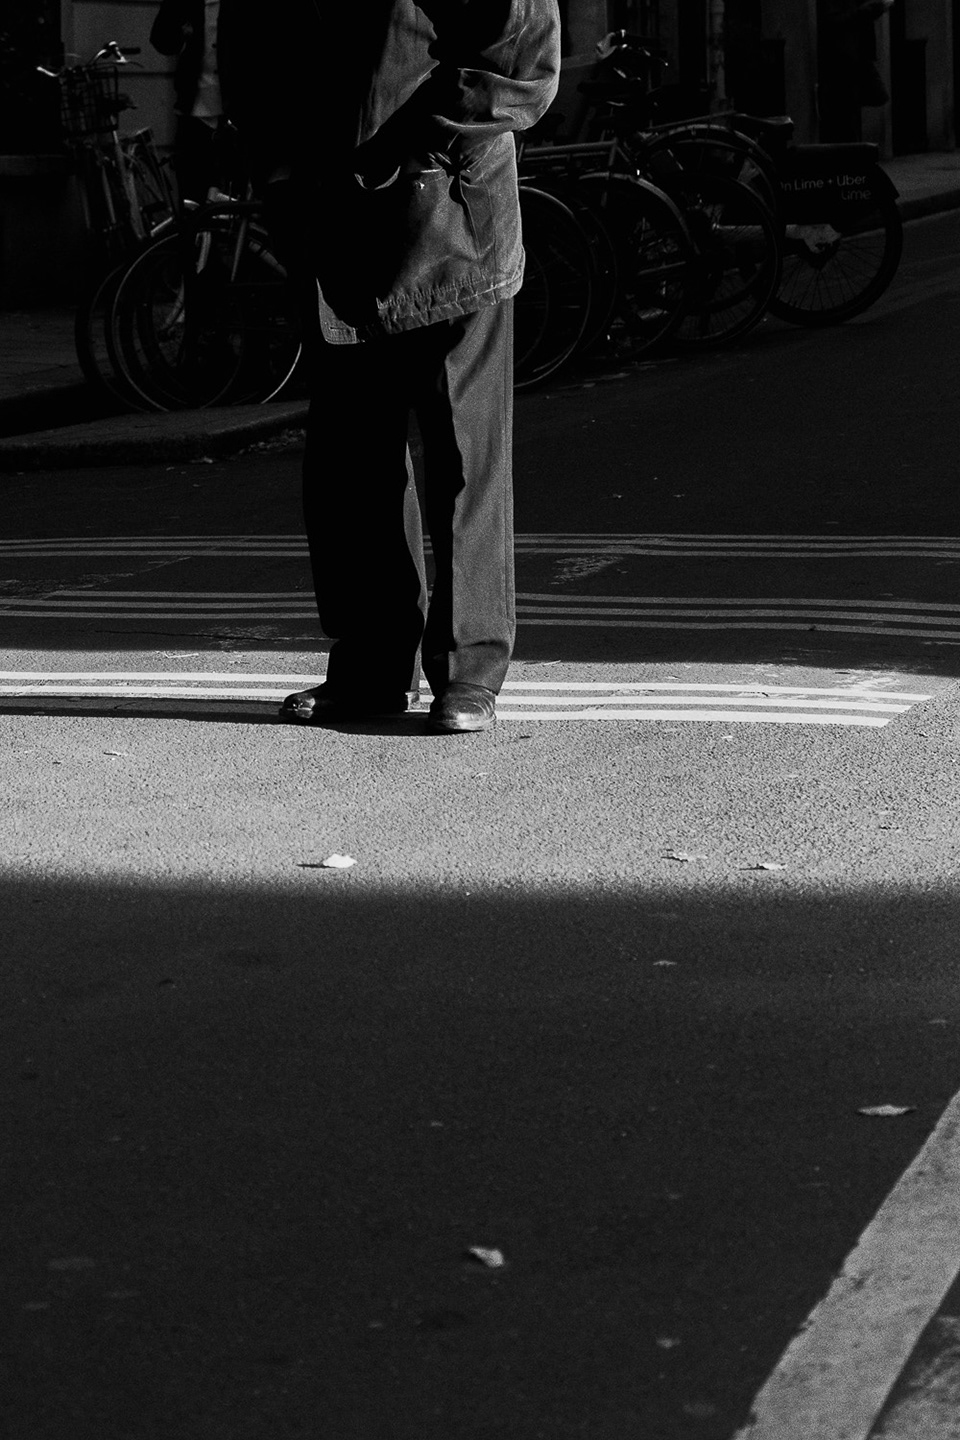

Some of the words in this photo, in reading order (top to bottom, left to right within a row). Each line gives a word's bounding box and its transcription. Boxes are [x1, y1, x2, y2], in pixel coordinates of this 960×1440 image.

[794, 178, 825, 191] Lime
[836, 174, 867, 187] Uber
[840, 189, 872, 201] Lime
